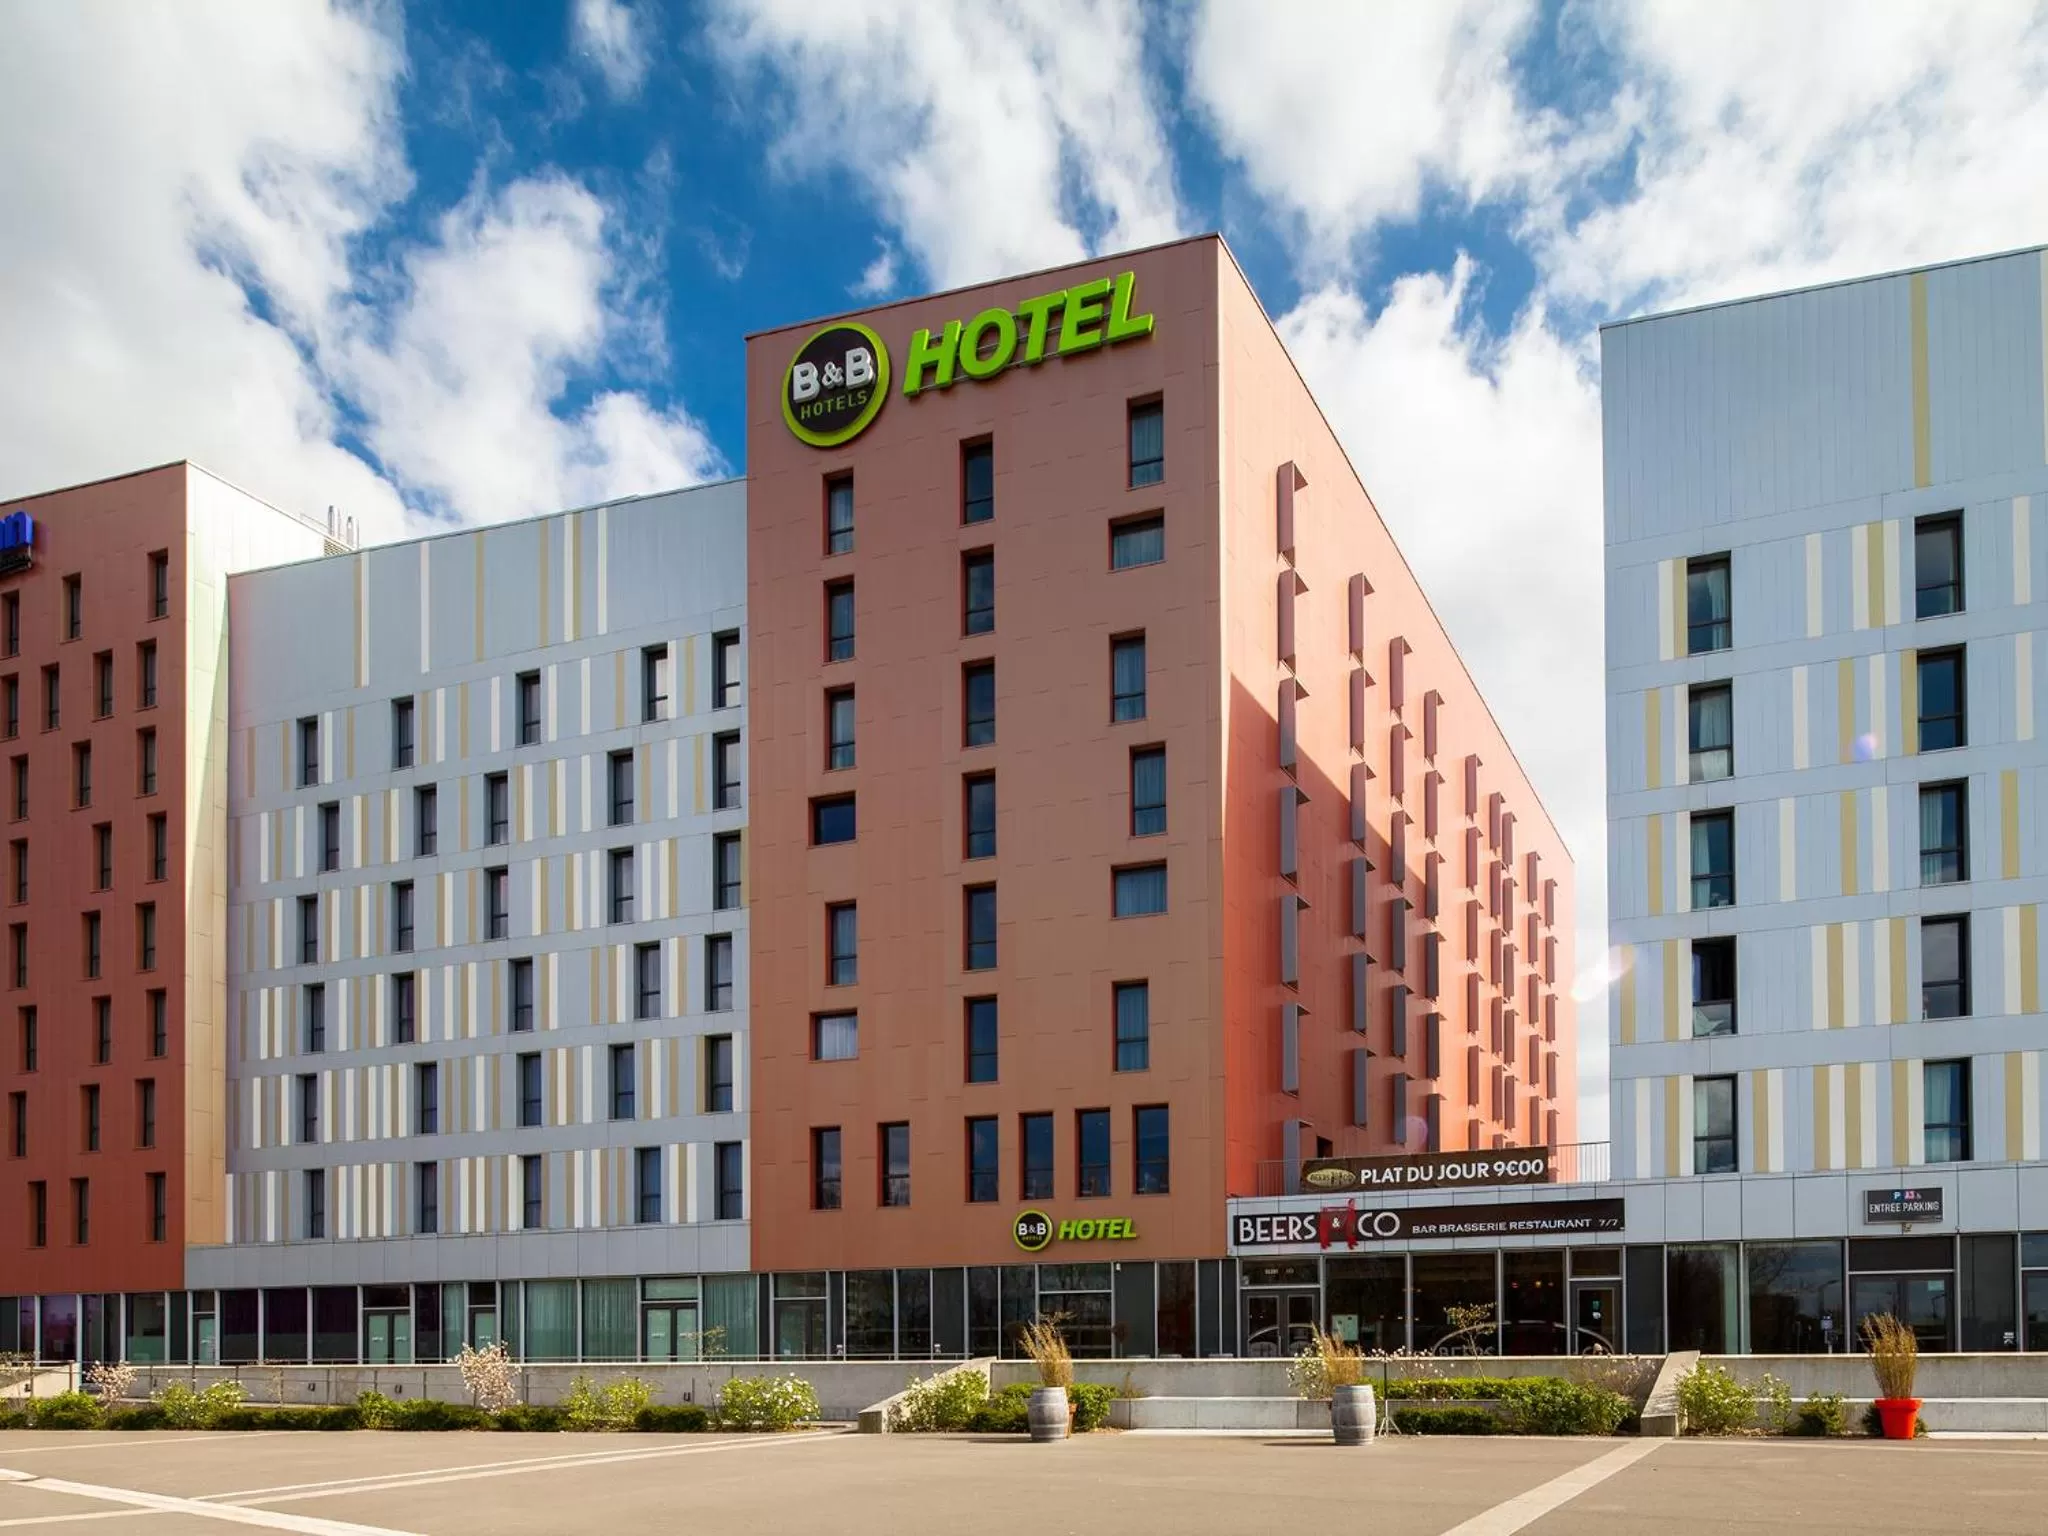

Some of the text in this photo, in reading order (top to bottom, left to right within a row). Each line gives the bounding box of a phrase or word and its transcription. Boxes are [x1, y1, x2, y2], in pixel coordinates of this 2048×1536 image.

[903, 271, 1154, 396] HOTEL
[793, 347, 875, 403] B&B
[801, 390, 868, 420] HOTELS
[1360, 1167, 1403, 1185] PLAT
[1407, 1165, 1433, 1182] DU
[1437, 1162, 1489, 1180] JOUR
[1903, 1200, 1940, 1212] PARKING
[1018, 1222, 1047, 1236] B&B
[1058, 1218, 1137, 1240] HOTEL
[1239, 1214, 1317, 1243] BEERS
[1357, 1211, 1400, 1238] CO
[1412, 1218, 1619, 1234] BAR BRASSERIE RESTAURANT 7/7
